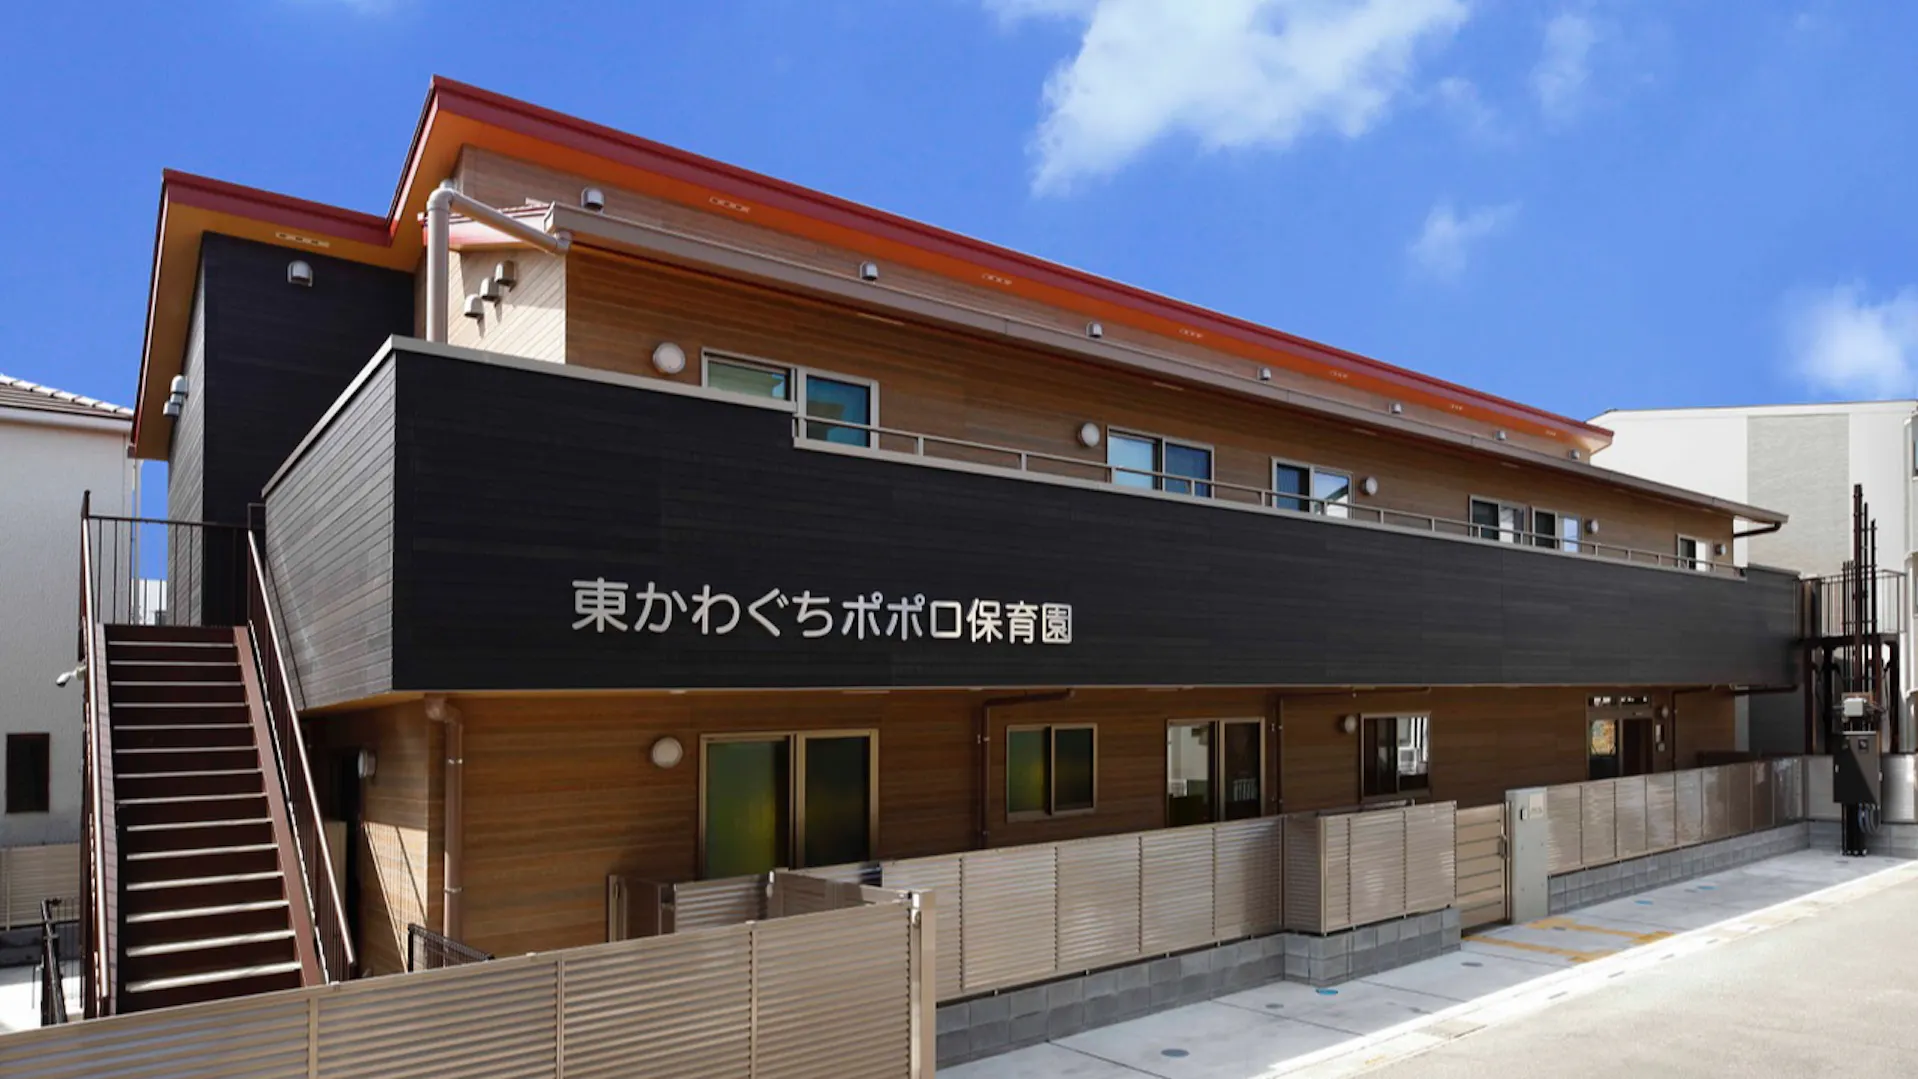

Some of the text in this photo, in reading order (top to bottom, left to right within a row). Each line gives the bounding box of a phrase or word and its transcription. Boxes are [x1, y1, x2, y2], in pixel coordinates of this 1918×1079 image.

[572, 577, 1073, 644] 東かわぐちポポロ保育園
